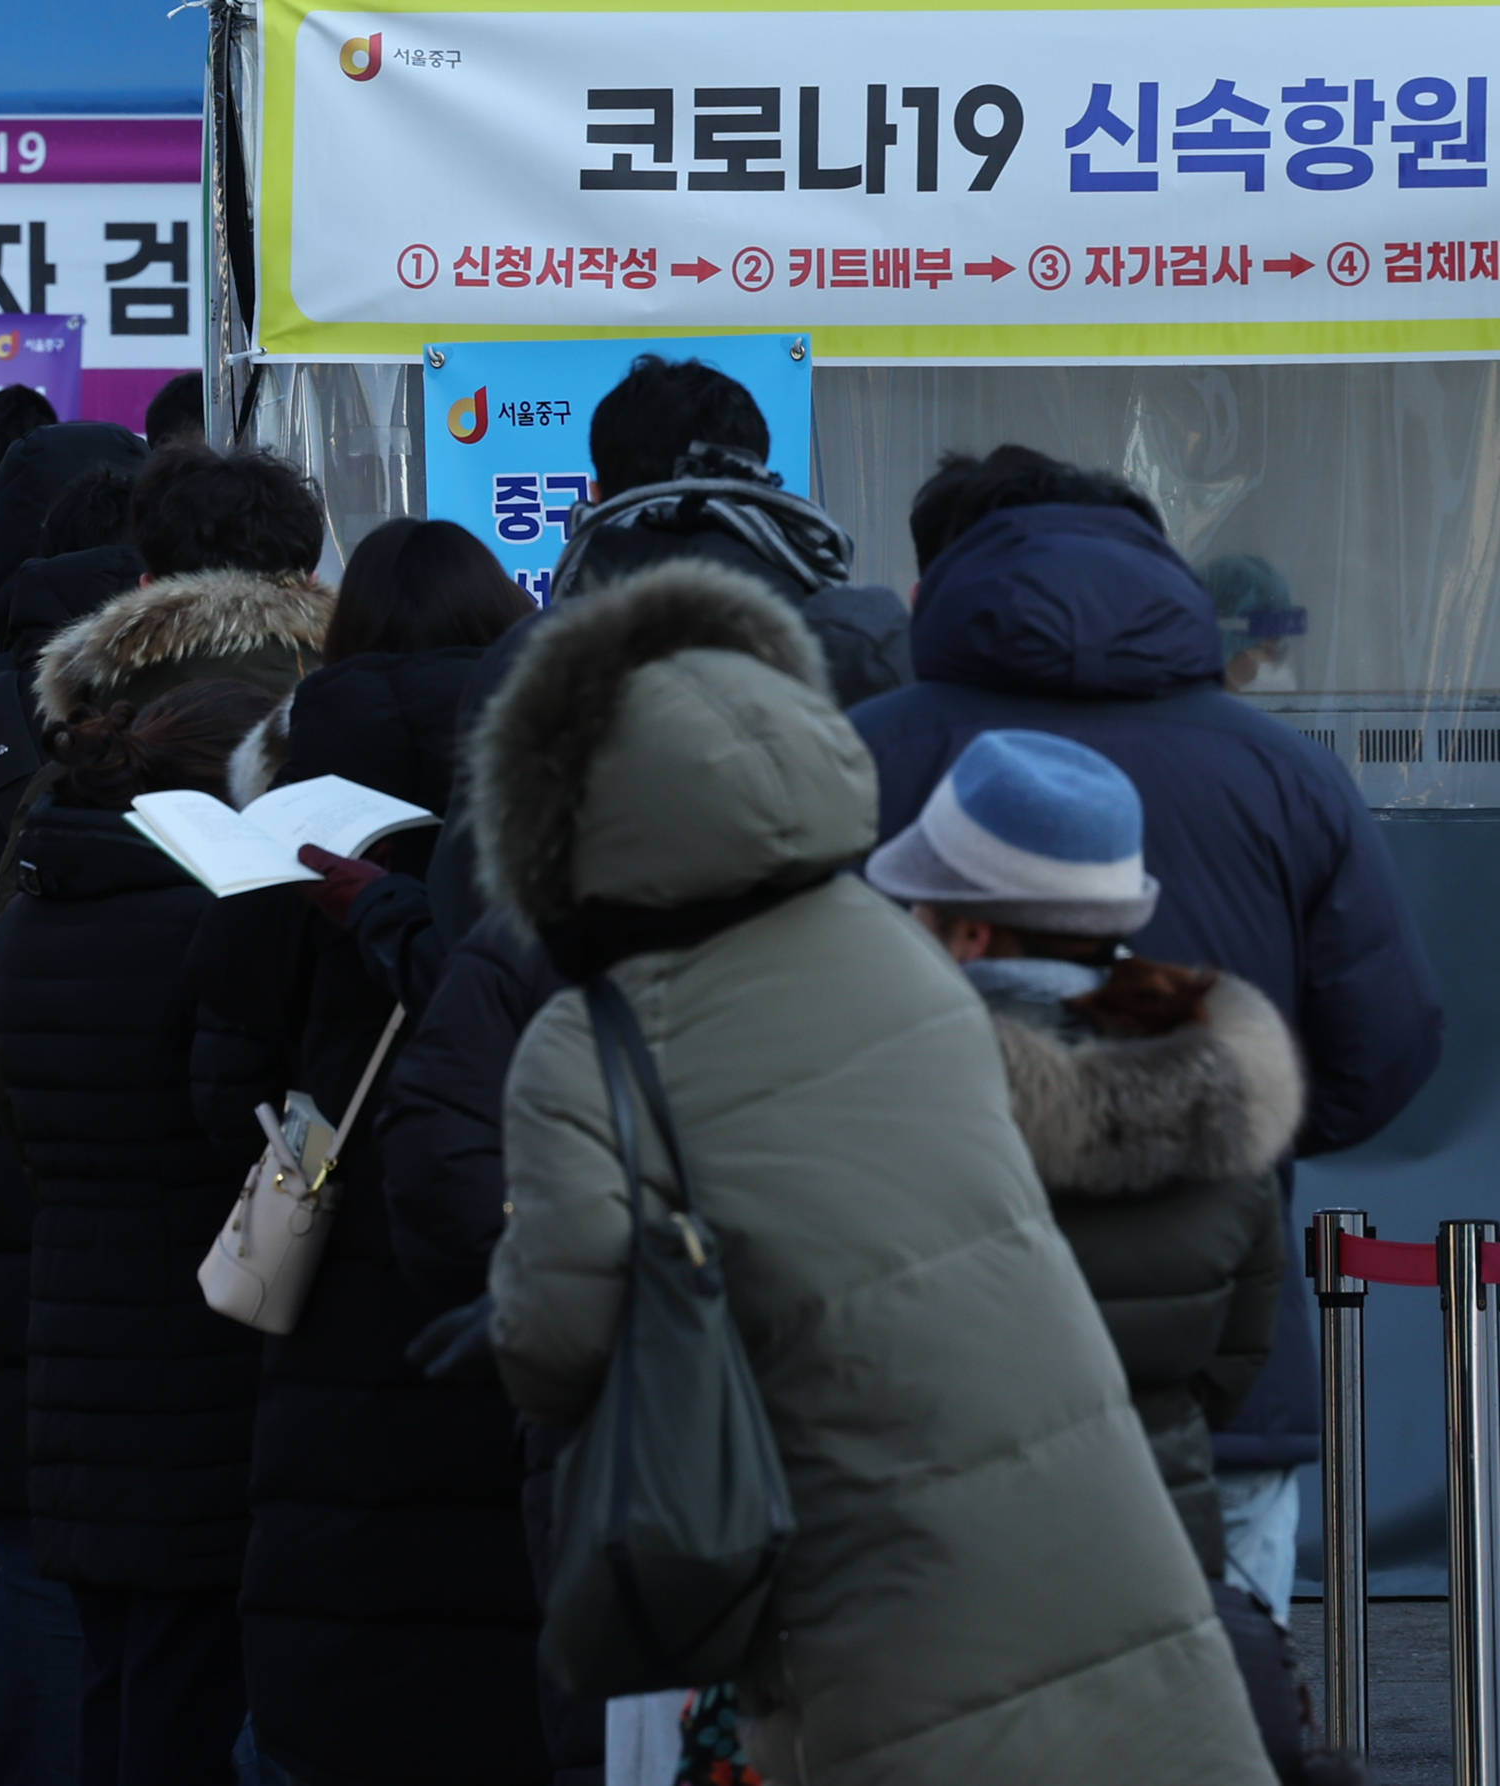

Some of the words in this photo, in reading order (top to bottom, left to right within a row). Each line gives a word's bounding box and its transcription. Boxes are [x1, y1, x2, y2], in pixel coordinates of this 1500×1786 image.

[393, 46, 462, 70] 서울중구
[580, 83, 1024, 194] 코로나19
[1065, 76, 1488, 193] 신속항원
[104, 221, 190, 336] 검
[452, 245, 658, 290] 신청서작성
[788, 246, 954, 290] 키트배부
[1085, 244, 1253, 287] 자가검사
[498, 400, 571, 427] 서울중구
[495, 475, 590, 542] 중구
